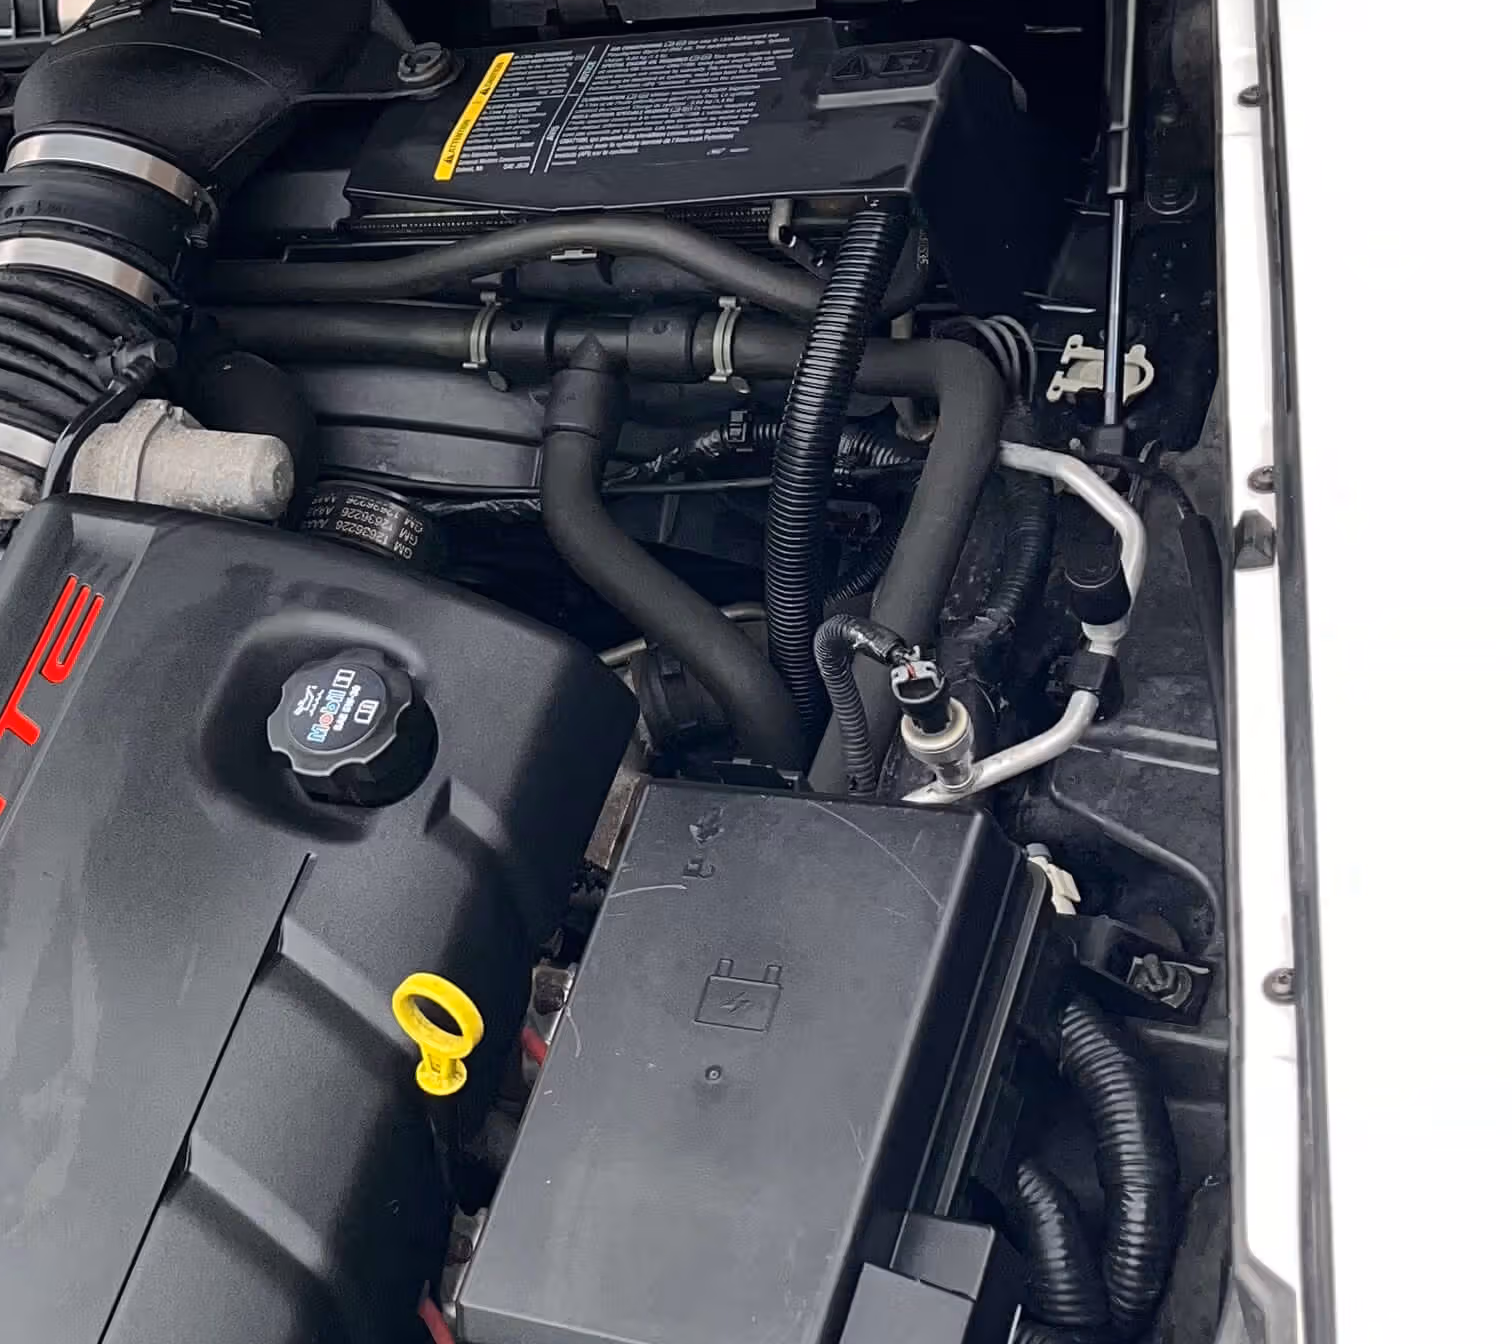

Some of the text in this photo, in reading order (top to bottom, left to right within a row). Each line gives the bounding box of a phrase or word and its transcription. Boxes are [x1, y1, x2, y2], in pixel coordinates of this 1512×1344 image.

[399, 527, 419, 546] GM
[393, 541, 413, 559] GM
[306, 688, 347, 743] Mobil
